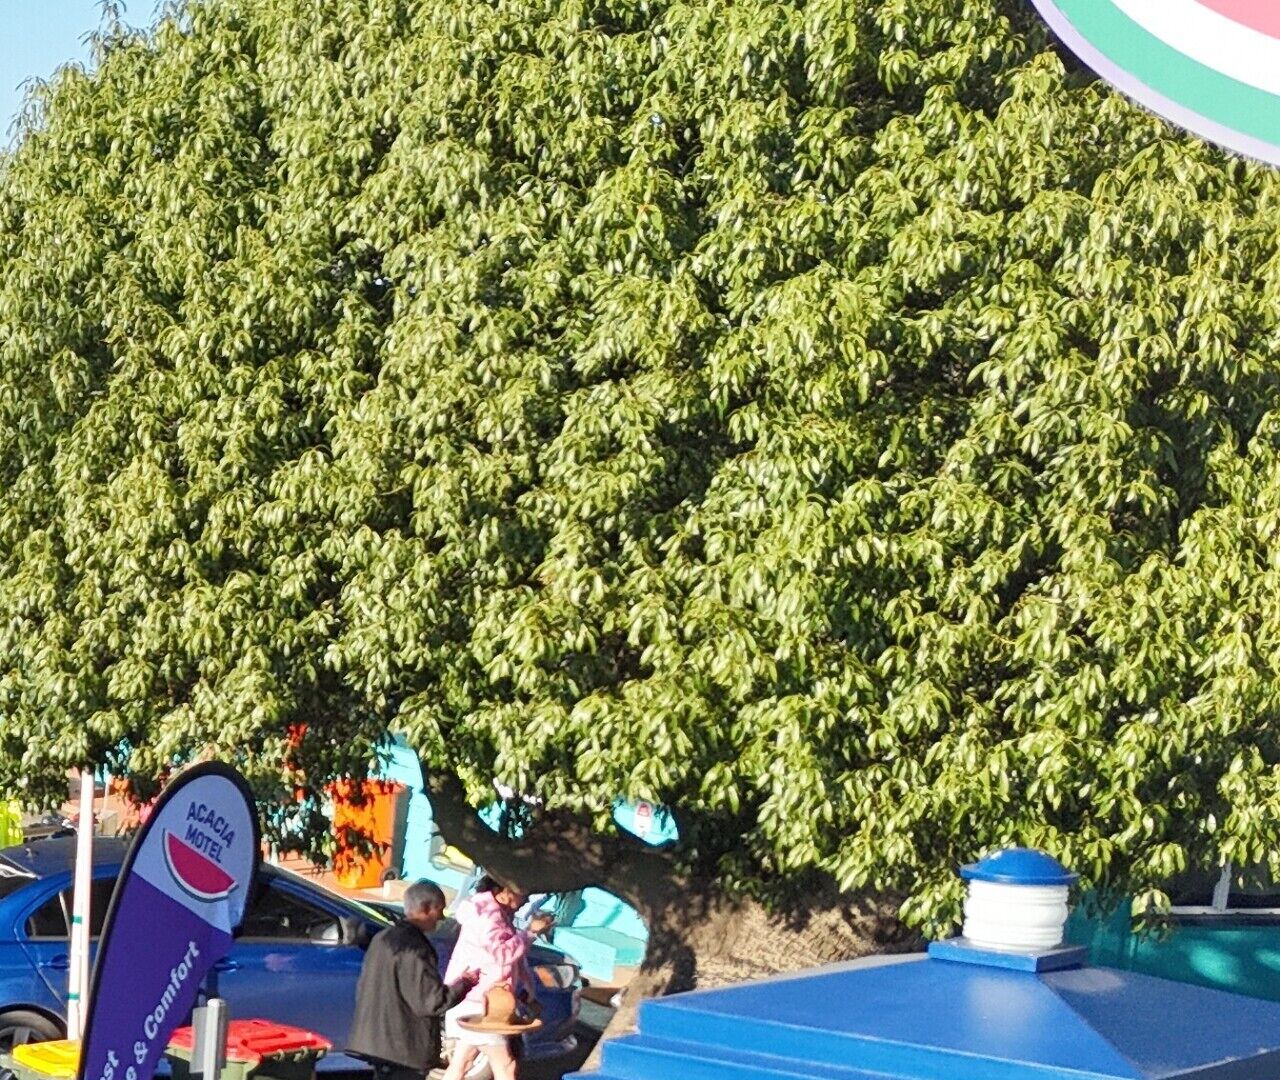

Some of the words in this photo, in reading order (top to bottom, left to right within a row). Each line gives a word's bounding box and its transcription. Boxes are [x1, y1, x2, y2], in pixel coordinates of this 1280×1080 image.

[185, 823, 223, 864] MOTEL
[186, 801, 235, 849] ACACIA
[134, 1041, 148, 1065] &
[144, 941, 200, 1040] Comfort
